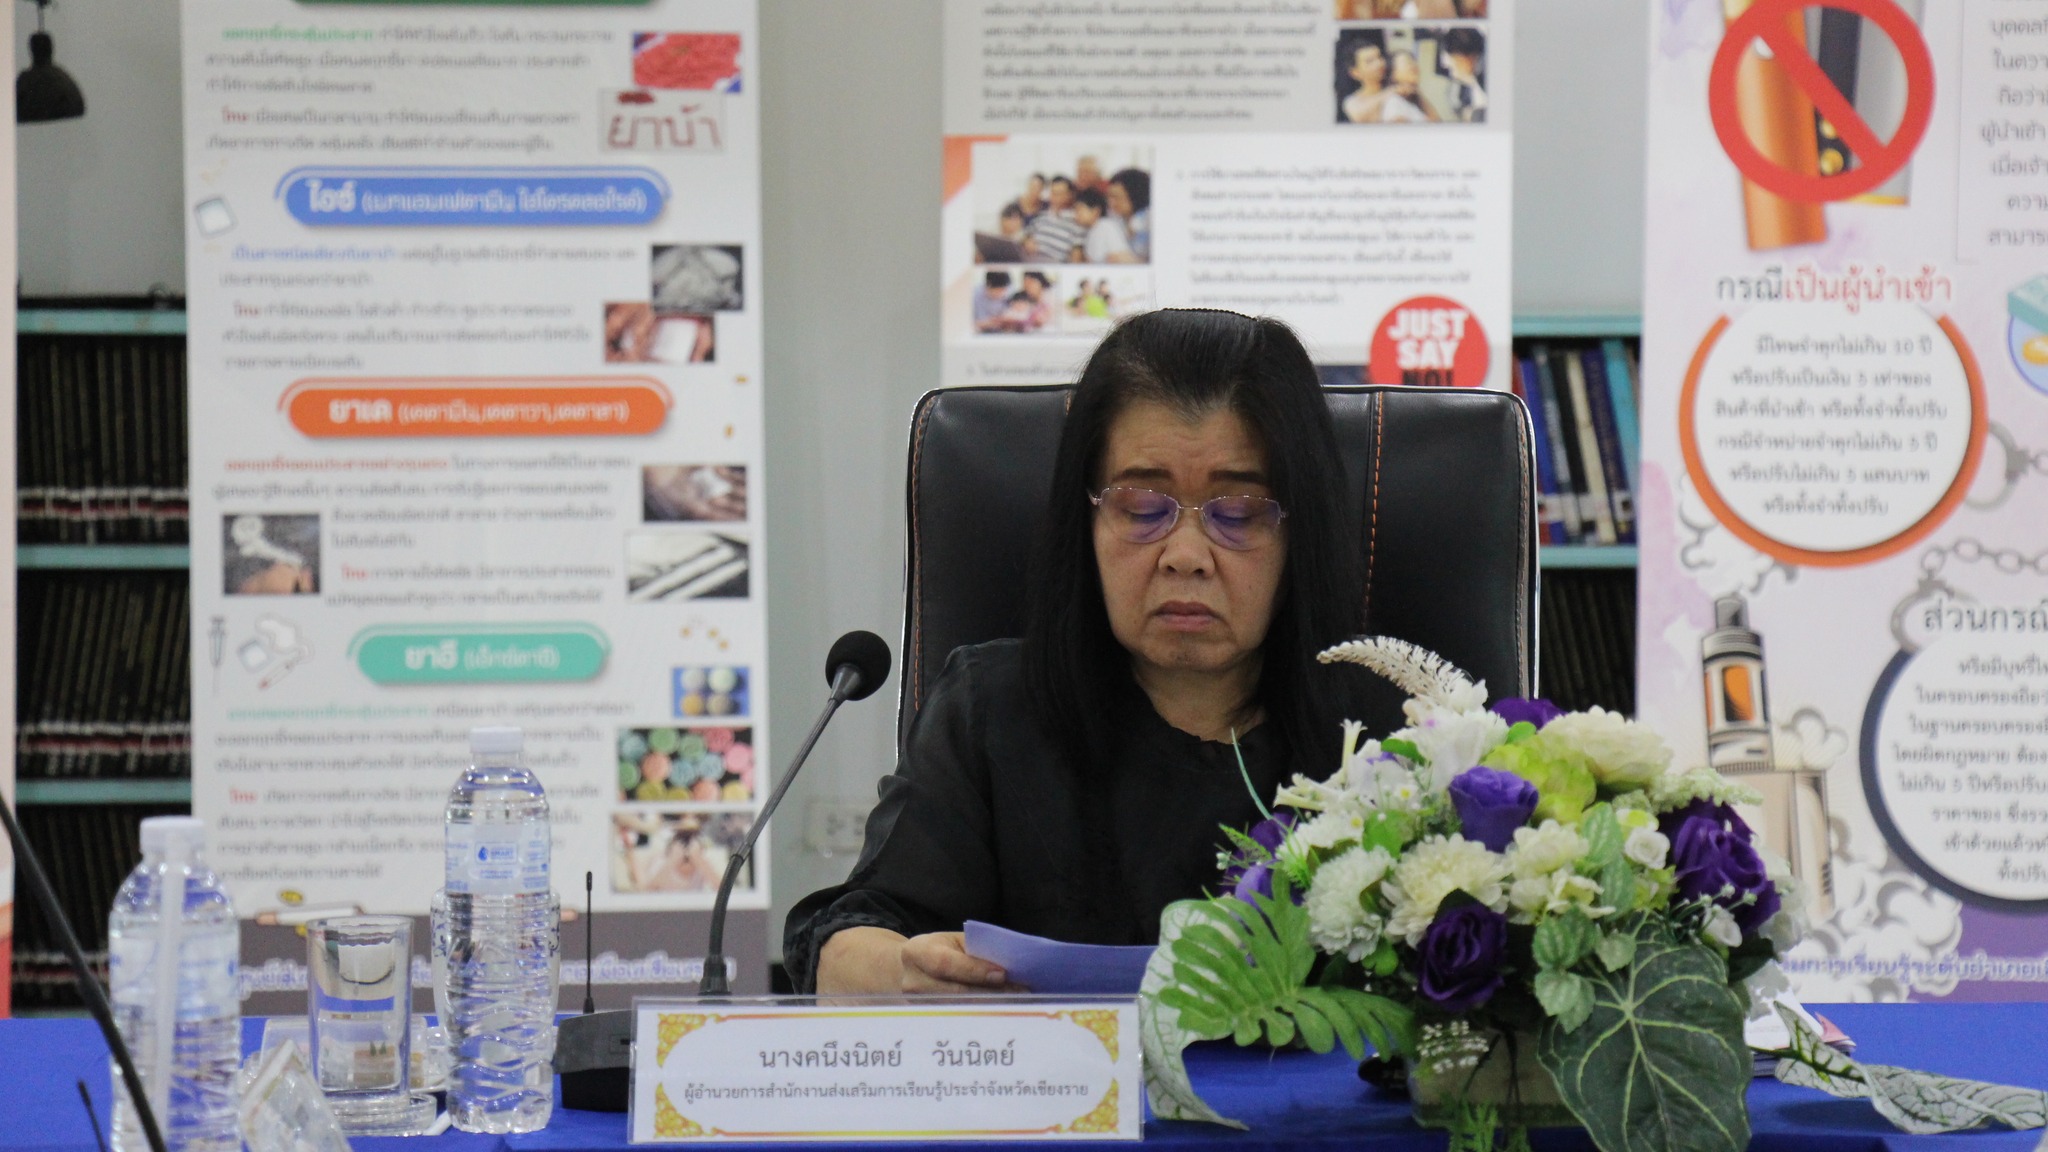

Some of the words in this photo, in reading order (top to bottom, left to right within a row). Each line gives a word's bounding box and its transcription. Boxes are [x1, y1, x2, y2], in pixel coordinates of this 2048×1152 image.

[606, 104, 724, 150] ยาบ้า
[1717, 265, 1952, 315] กรณีเป็นผู้นำเข้า
[1387, 308, 1469, 340] JUST
[1397, 338, 1459, 369] SAY
[759, 1040, 903, 1069] นางคนึงนิตย์
[932, 1039, 1016, 1068] วันนิตย์
[683, 1080, 1089, 1104] ผู้อำนวยการสำนักงานส่งเสริมการเรียนรู้ประจำจังหวัดเชียงราย
